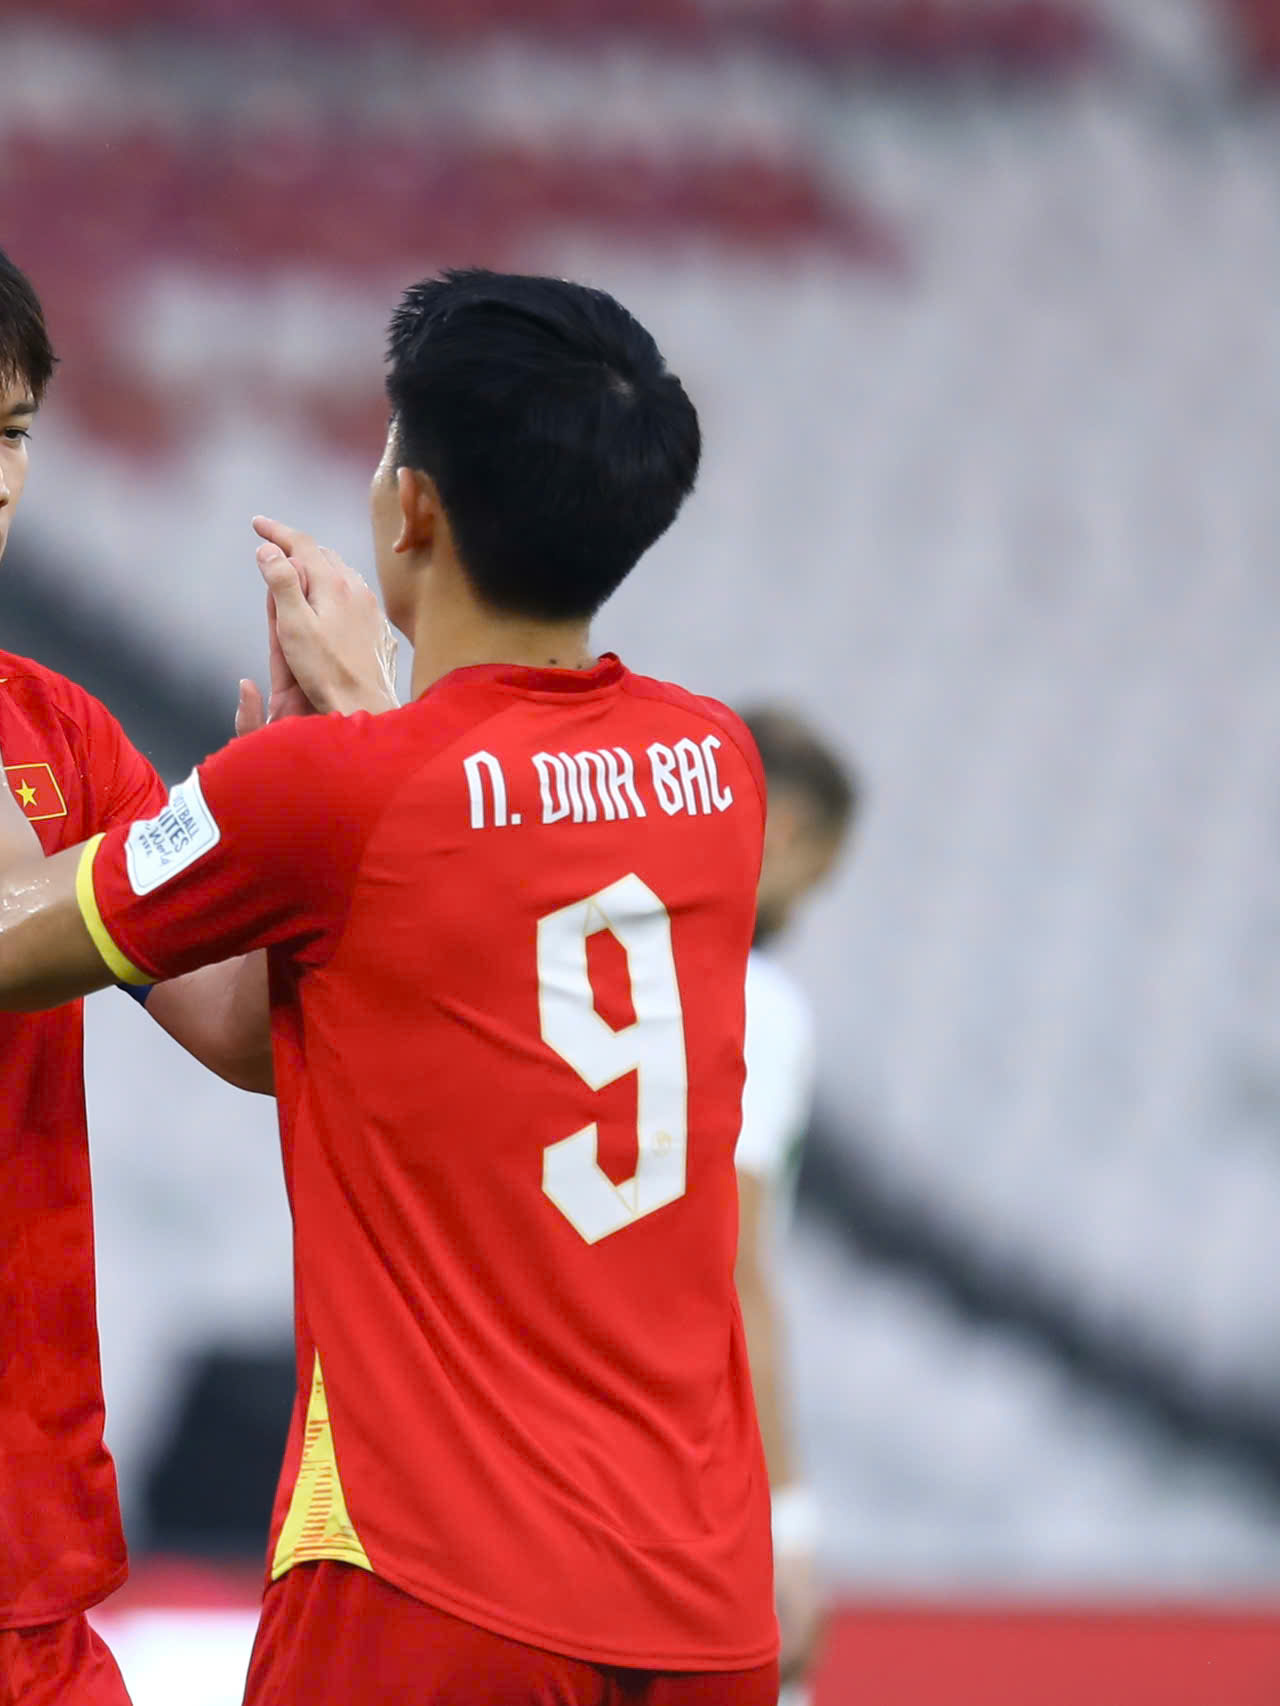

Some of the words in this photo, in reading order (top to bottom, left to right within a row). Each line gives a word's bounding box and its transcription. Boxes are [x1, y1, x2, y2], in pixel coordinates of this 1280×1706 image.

[531, 747, 647, 825] DINH
[646, 734, 734, 817] BAC
[158, 808, 190, 854] ITES
[536, 872, 689, 1246] 9
